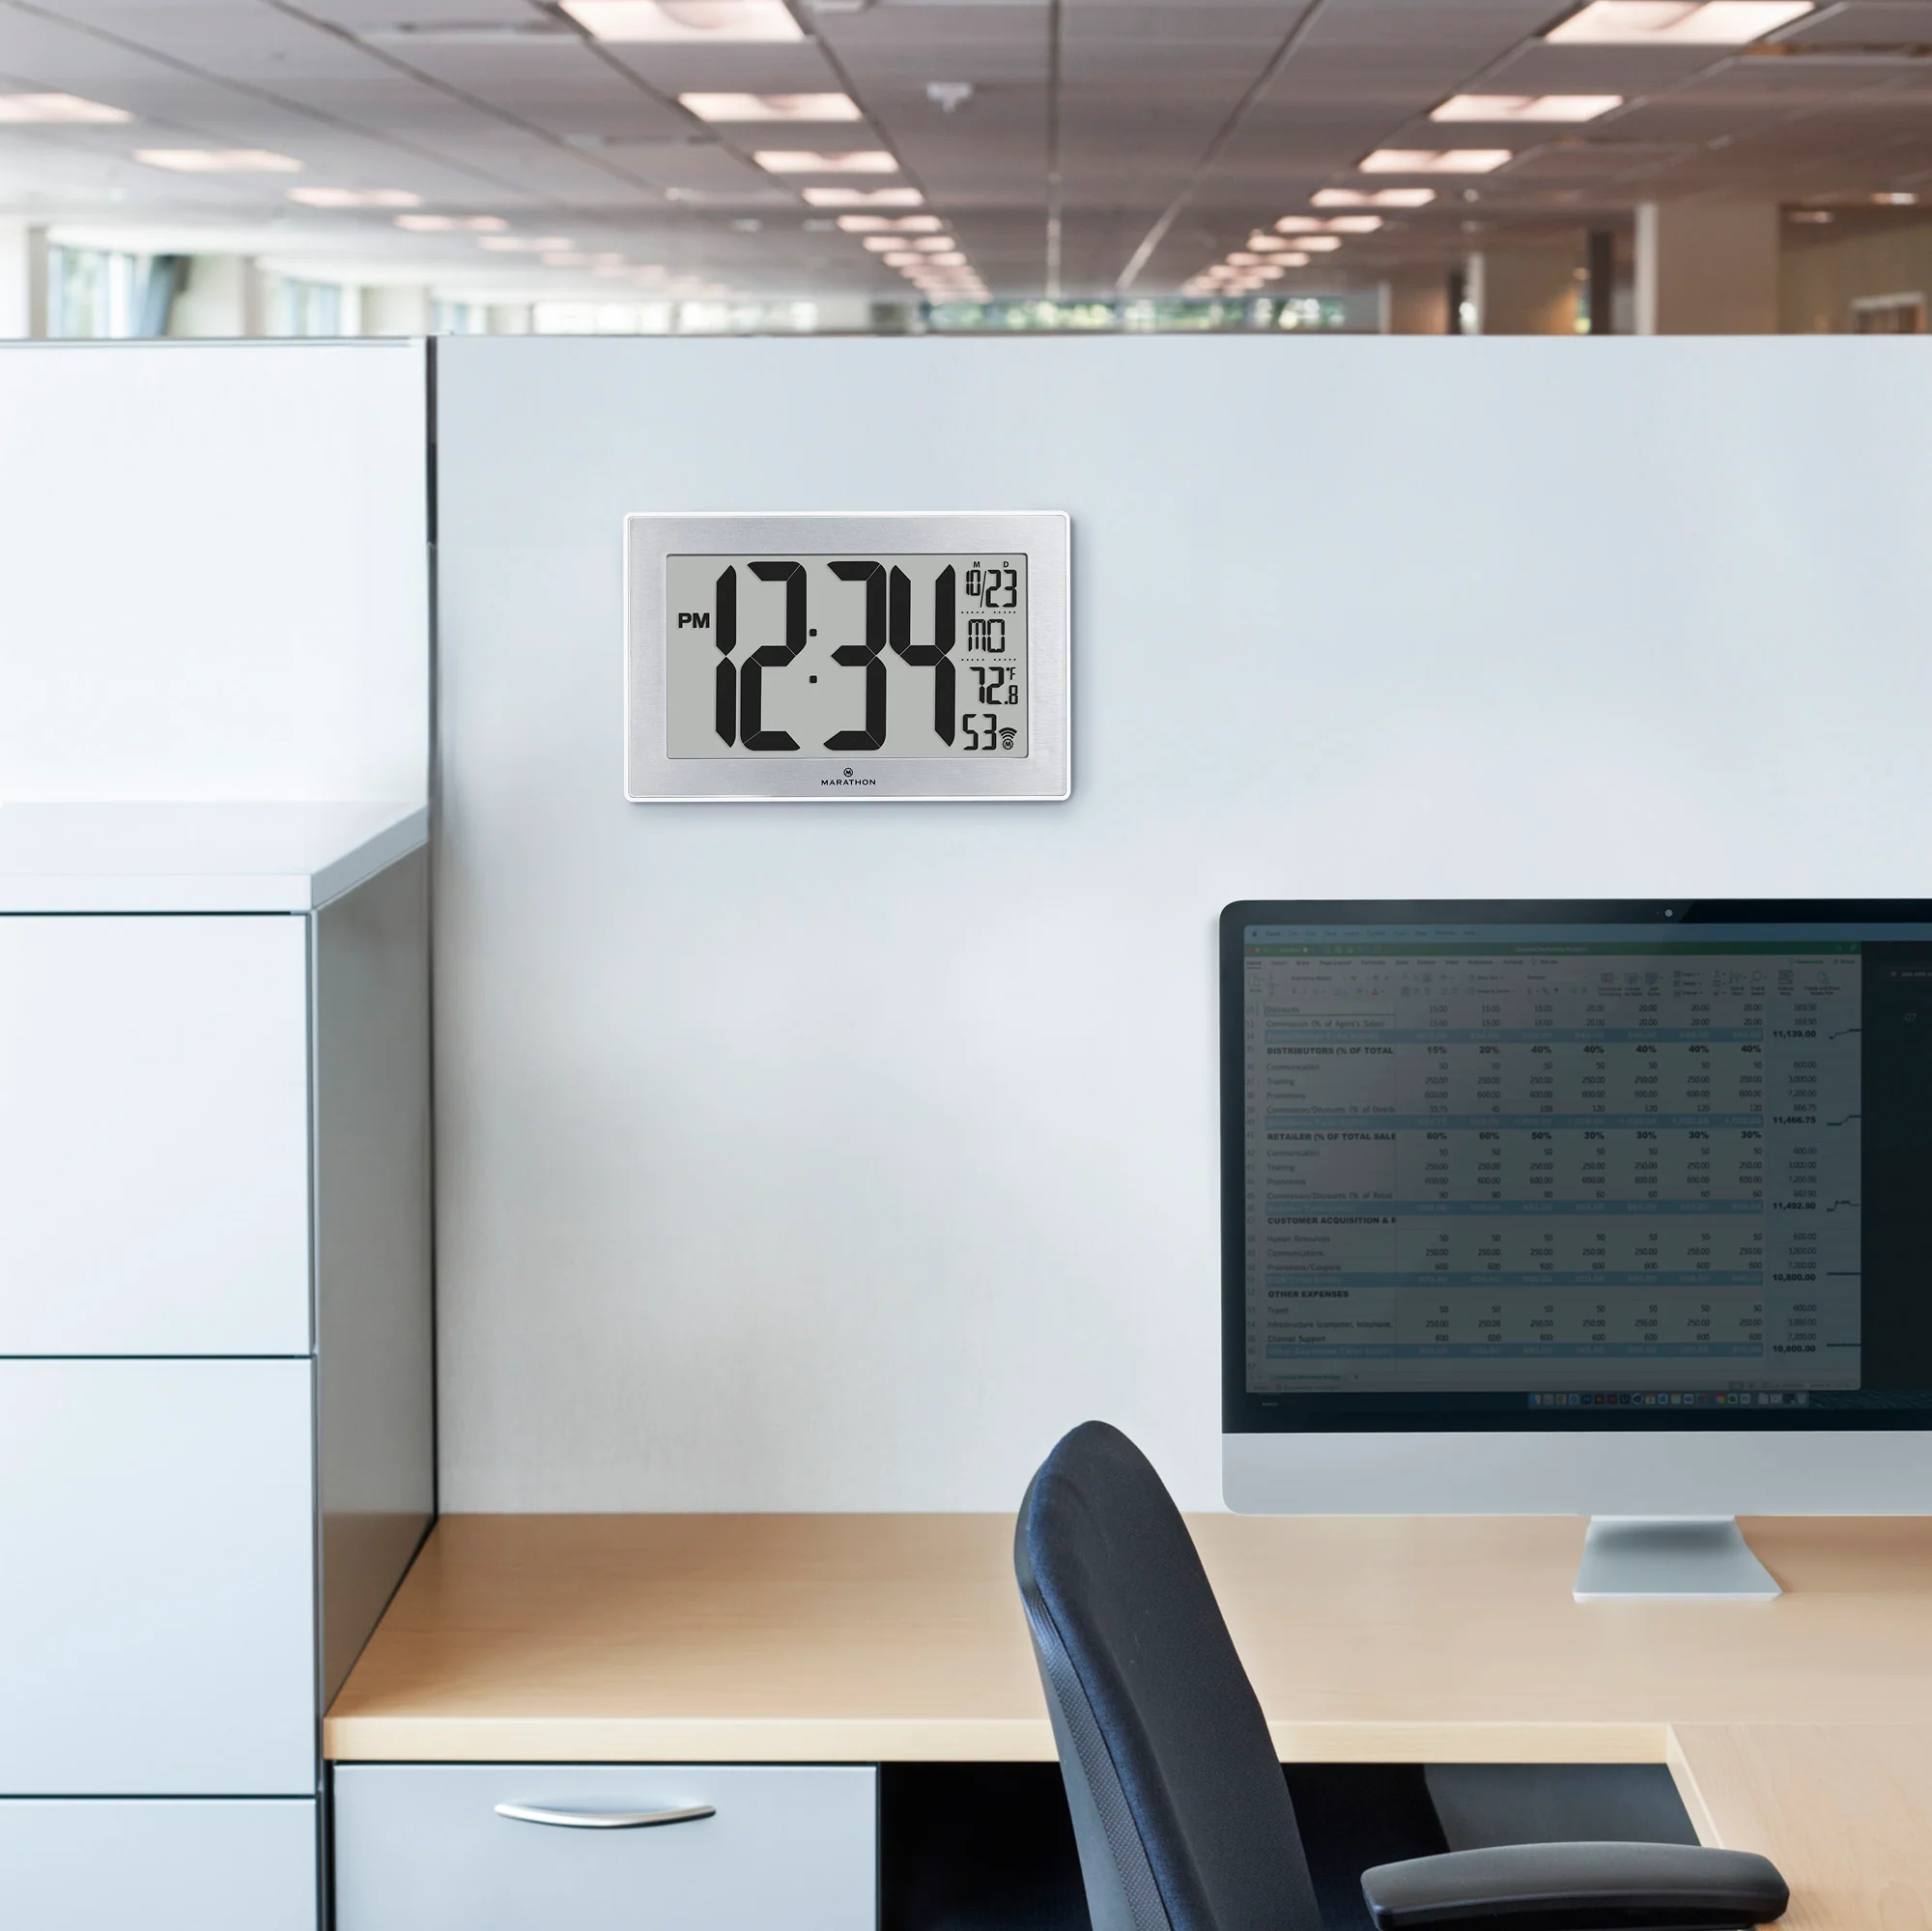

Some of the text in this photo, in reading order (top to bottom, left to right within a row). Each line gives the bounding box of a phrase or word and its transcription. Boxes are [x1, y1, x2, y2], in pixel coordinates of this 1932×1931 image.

[965, 569, 1017, 608] 10/23
[677, 612, 710, 629] PM
[968, 618, 1006, 653] MO
[716, 560, 956, 752] 12:34
[962, 713, 997, 751] 53
[1350, 1046, 1361, 1055] OF
[1427, 1044, 1761, 1055] 15% 20% 40% 40% 40% 40% 40%
[1374, 1132, 1396, 1141] SALE
[1427, 1130, 1761, 1141] 60% 60% 50% 30% 30% 30% 30%
[1267, 1216, 1319, 1225] CUSTOMER
[1321, 1216, 1379, 1225] ACQUISITION
[1267, 1290, 1349, 1298] OTHER EXPENSES
[1297, 1335, 1326, 1344] Support
